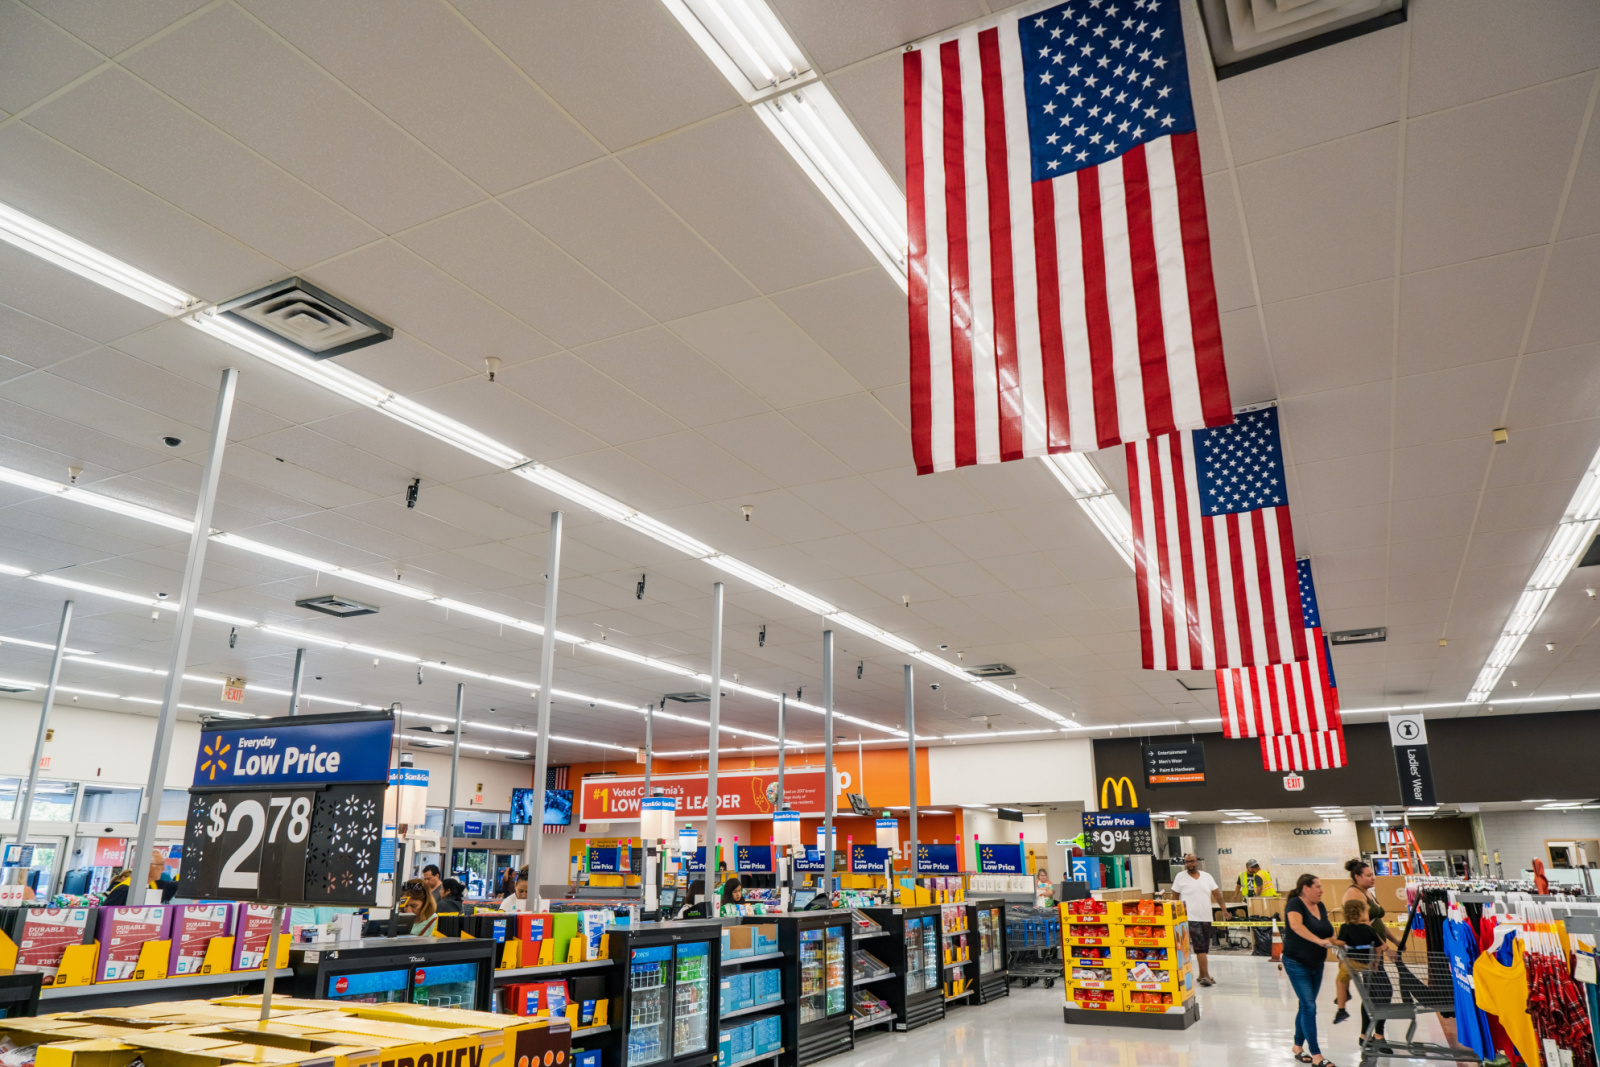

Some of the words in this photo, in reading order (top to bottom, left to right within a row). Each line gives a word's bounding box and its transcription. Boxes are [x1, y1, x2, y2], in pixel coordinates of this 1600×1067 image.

[227, 687, 242, 702] EXIT
[238, 736, 277, 749] Everyday
[40, 757, 51, 768] XIT
[233, 750, 280, 776] Low
[282, 745, 341, 774] Price
[1407, 749, 1421, 777] Ladies'
[405, 773, 429, 781] Scan&Go
[1286, 776, 1301, 790] EXIT
[1412, 778, 1423, 801] Wear
[593, 788, 609, 812] #1
[612, 787, 636, 797] Voted
[611, 798, 640, 812] LOW
[1114, 818, 1134, 826] Price
[1293, 827, 1331, 836] Charleston
[103, 849, 119, 859] Free
